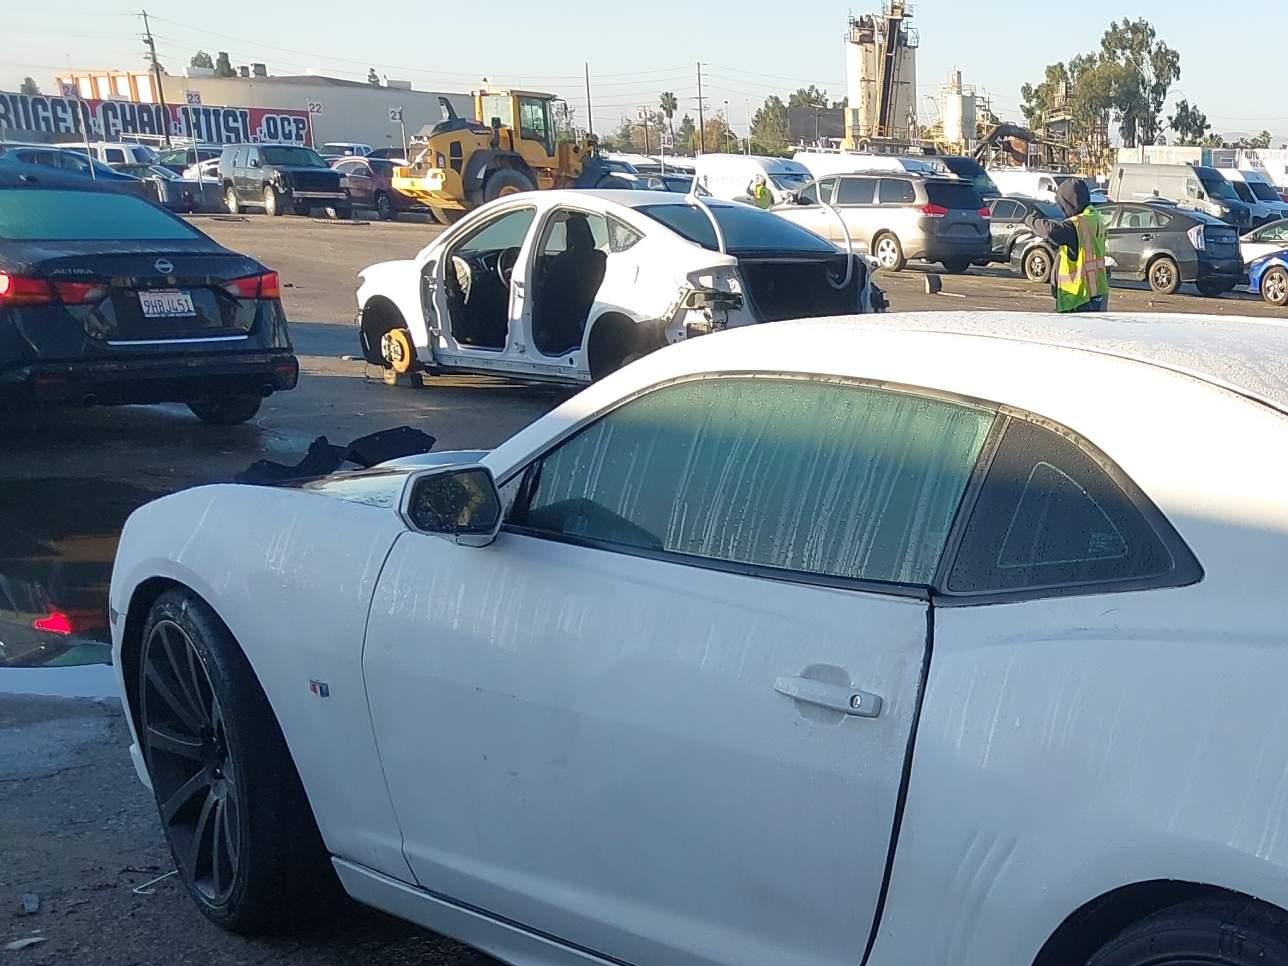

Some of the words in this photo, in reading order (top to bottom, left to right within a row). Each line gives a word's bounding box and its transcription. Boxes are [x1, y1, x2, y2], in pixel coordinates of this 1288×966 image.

[187, 94, 201, 104] 23
[309, 103, 322, 113] 22
[390, 110, 402, 120] 21
[662, 136, 673, 146] 18
